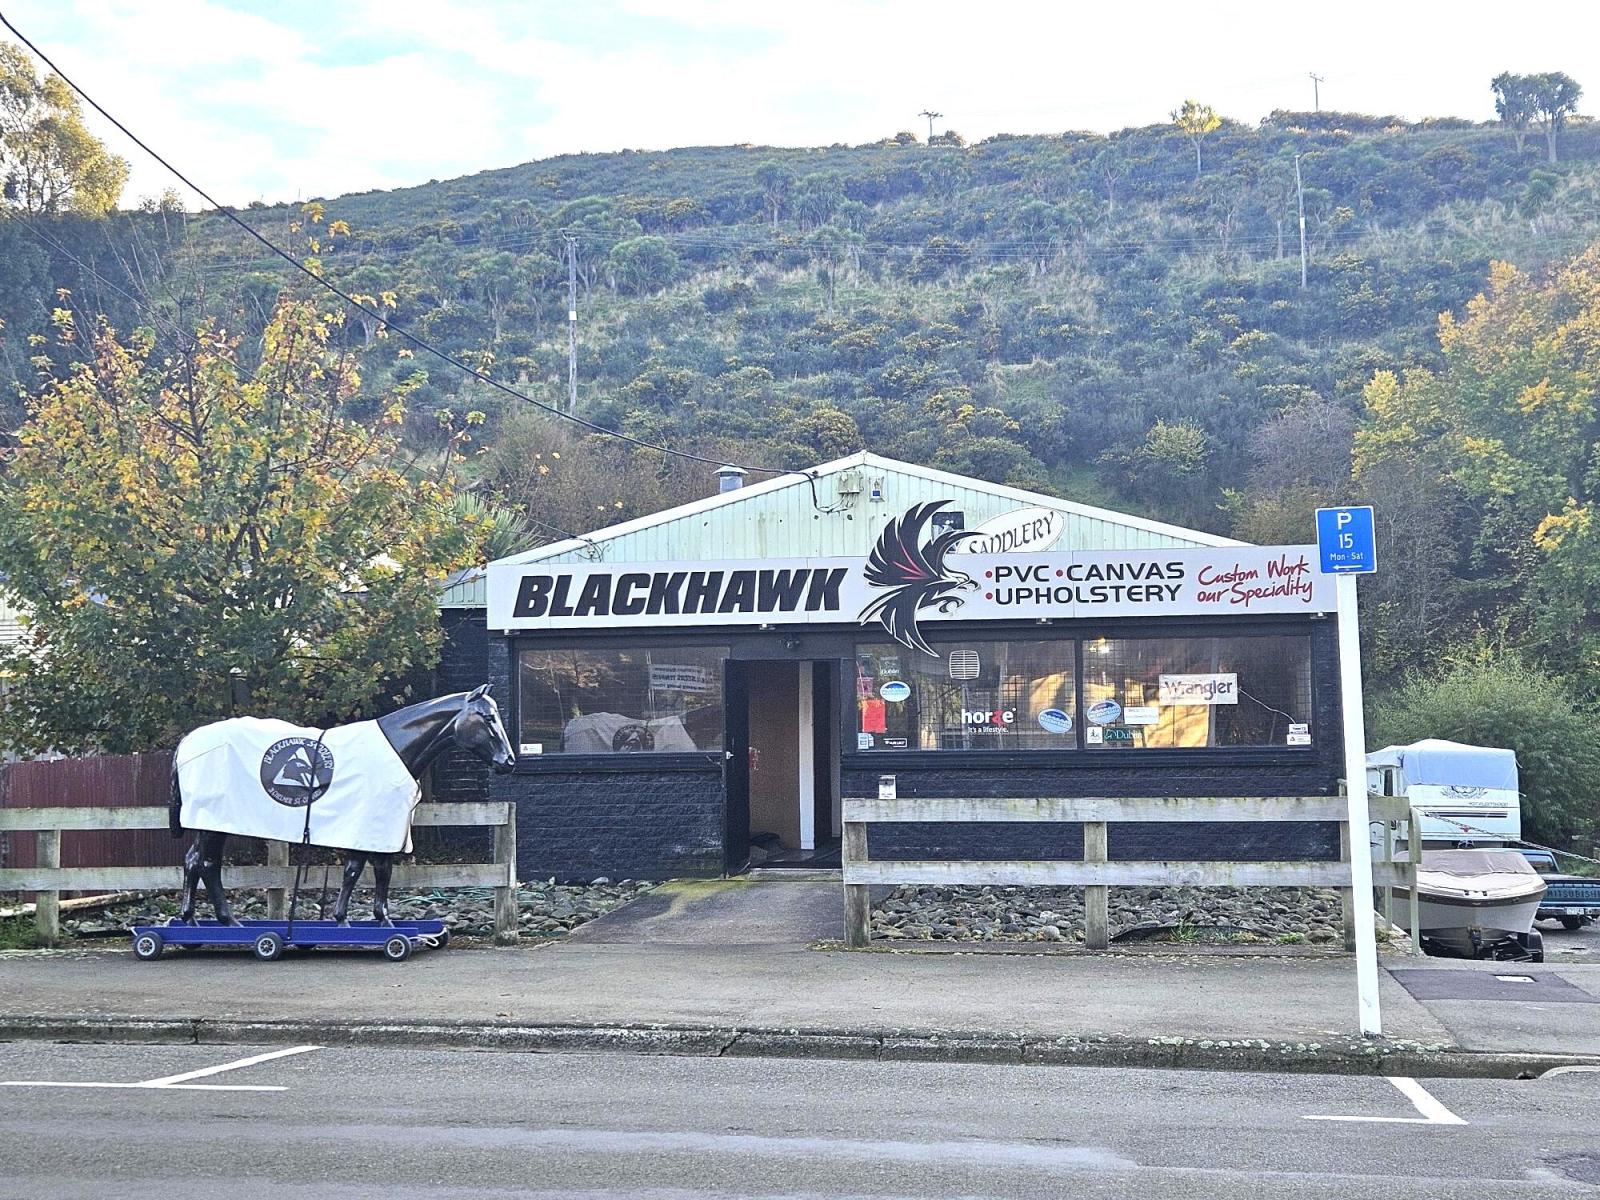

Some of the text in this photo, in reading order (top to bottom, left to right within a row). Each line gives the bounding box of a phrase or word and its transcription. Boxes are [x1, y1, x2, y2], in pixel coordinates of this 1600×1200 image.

[1337, 512, 1352, 530] P
[969, 511, 1054, 553] SADDLERY
[1339, 533, 1353, 549] 15
[1351, 552, 1363, 560] Sat
[995, 562, 1185, 583] PVC CANVAS
[1198, 554, 1310, 585] Custom Work
[513, 568, 848, 618] BLACKHAWK
[995, 584, 1183, 605] UPHOLSTERY
[1197, 575, 1313, 607] our Speciality
[1164, 680, 1233, 700] Wrangler
[264, 738, 307, 765] BLACKHAWK
